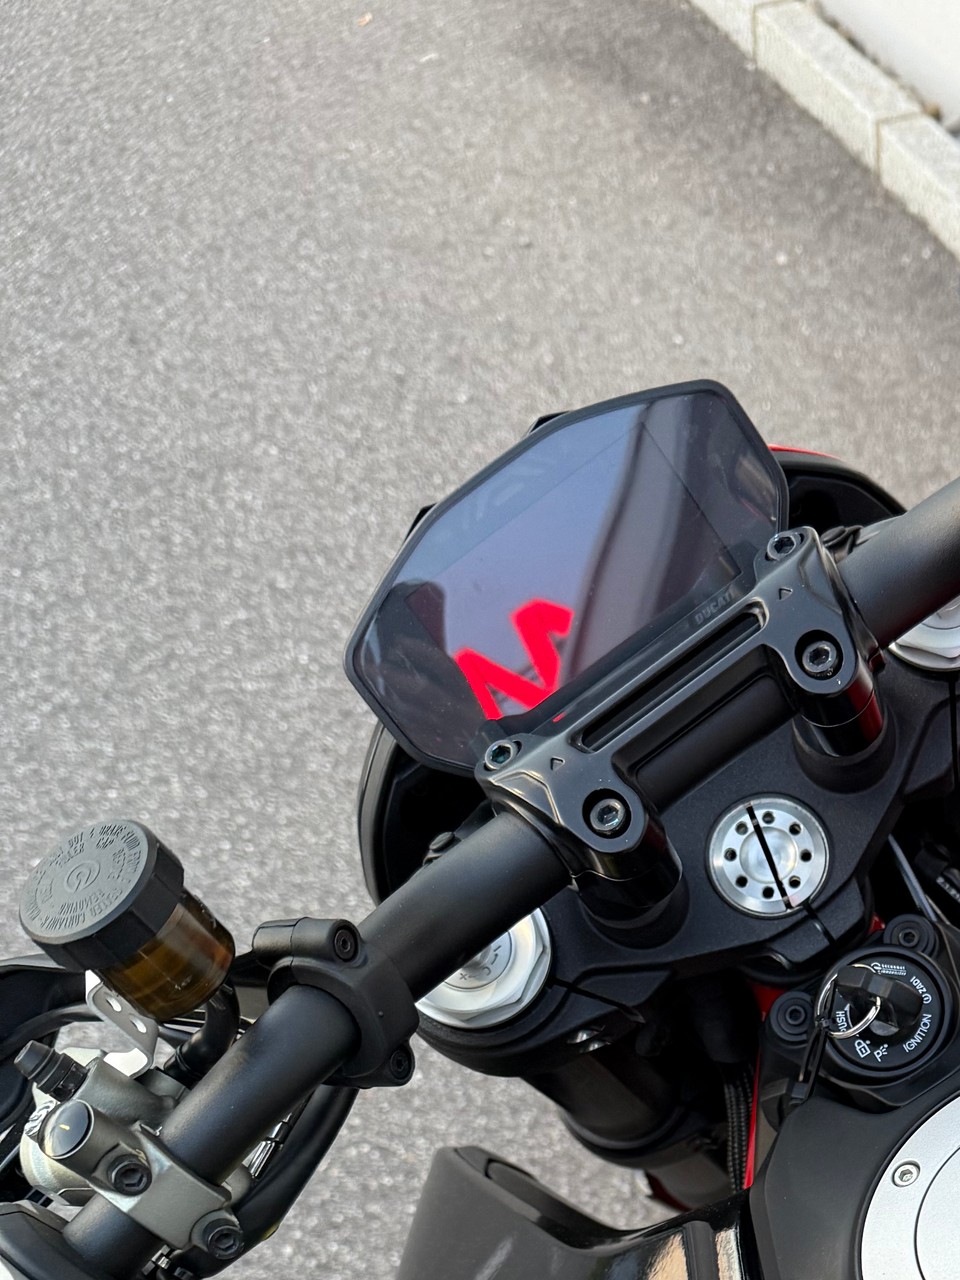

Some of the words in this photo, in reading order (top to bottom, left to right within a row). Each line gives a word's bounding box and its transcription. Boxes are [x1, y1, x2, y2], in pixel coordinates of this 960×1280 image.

[695, 588, 735, 625] DUCATI
[910, 976, 927, 994] ZADI
[902, 1013, 932, 1053] IGNITION
